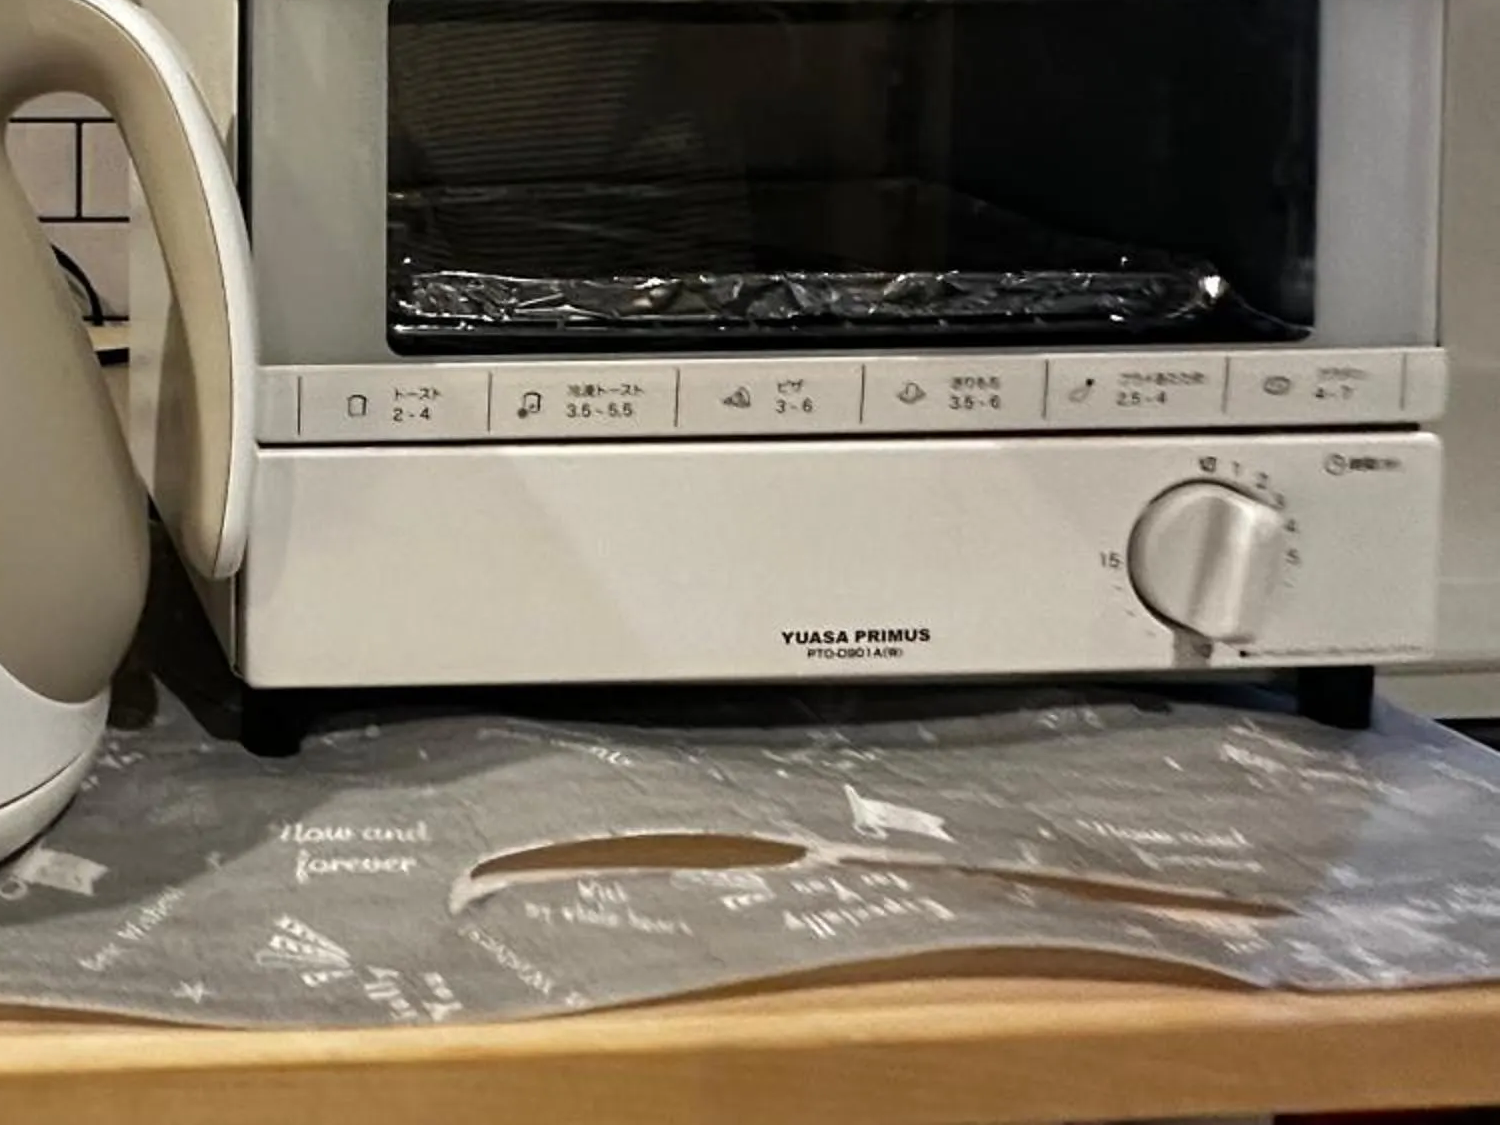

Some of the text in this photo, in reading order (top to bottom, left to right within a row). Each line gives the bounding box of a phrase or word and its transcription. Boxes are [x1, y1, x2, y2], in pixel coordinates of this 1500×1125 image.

[393, 386, 442, 401] トースト
[1100, 551, 1124, 569] 15
[781, 627, 931, 645] YUASA PRIMUS
